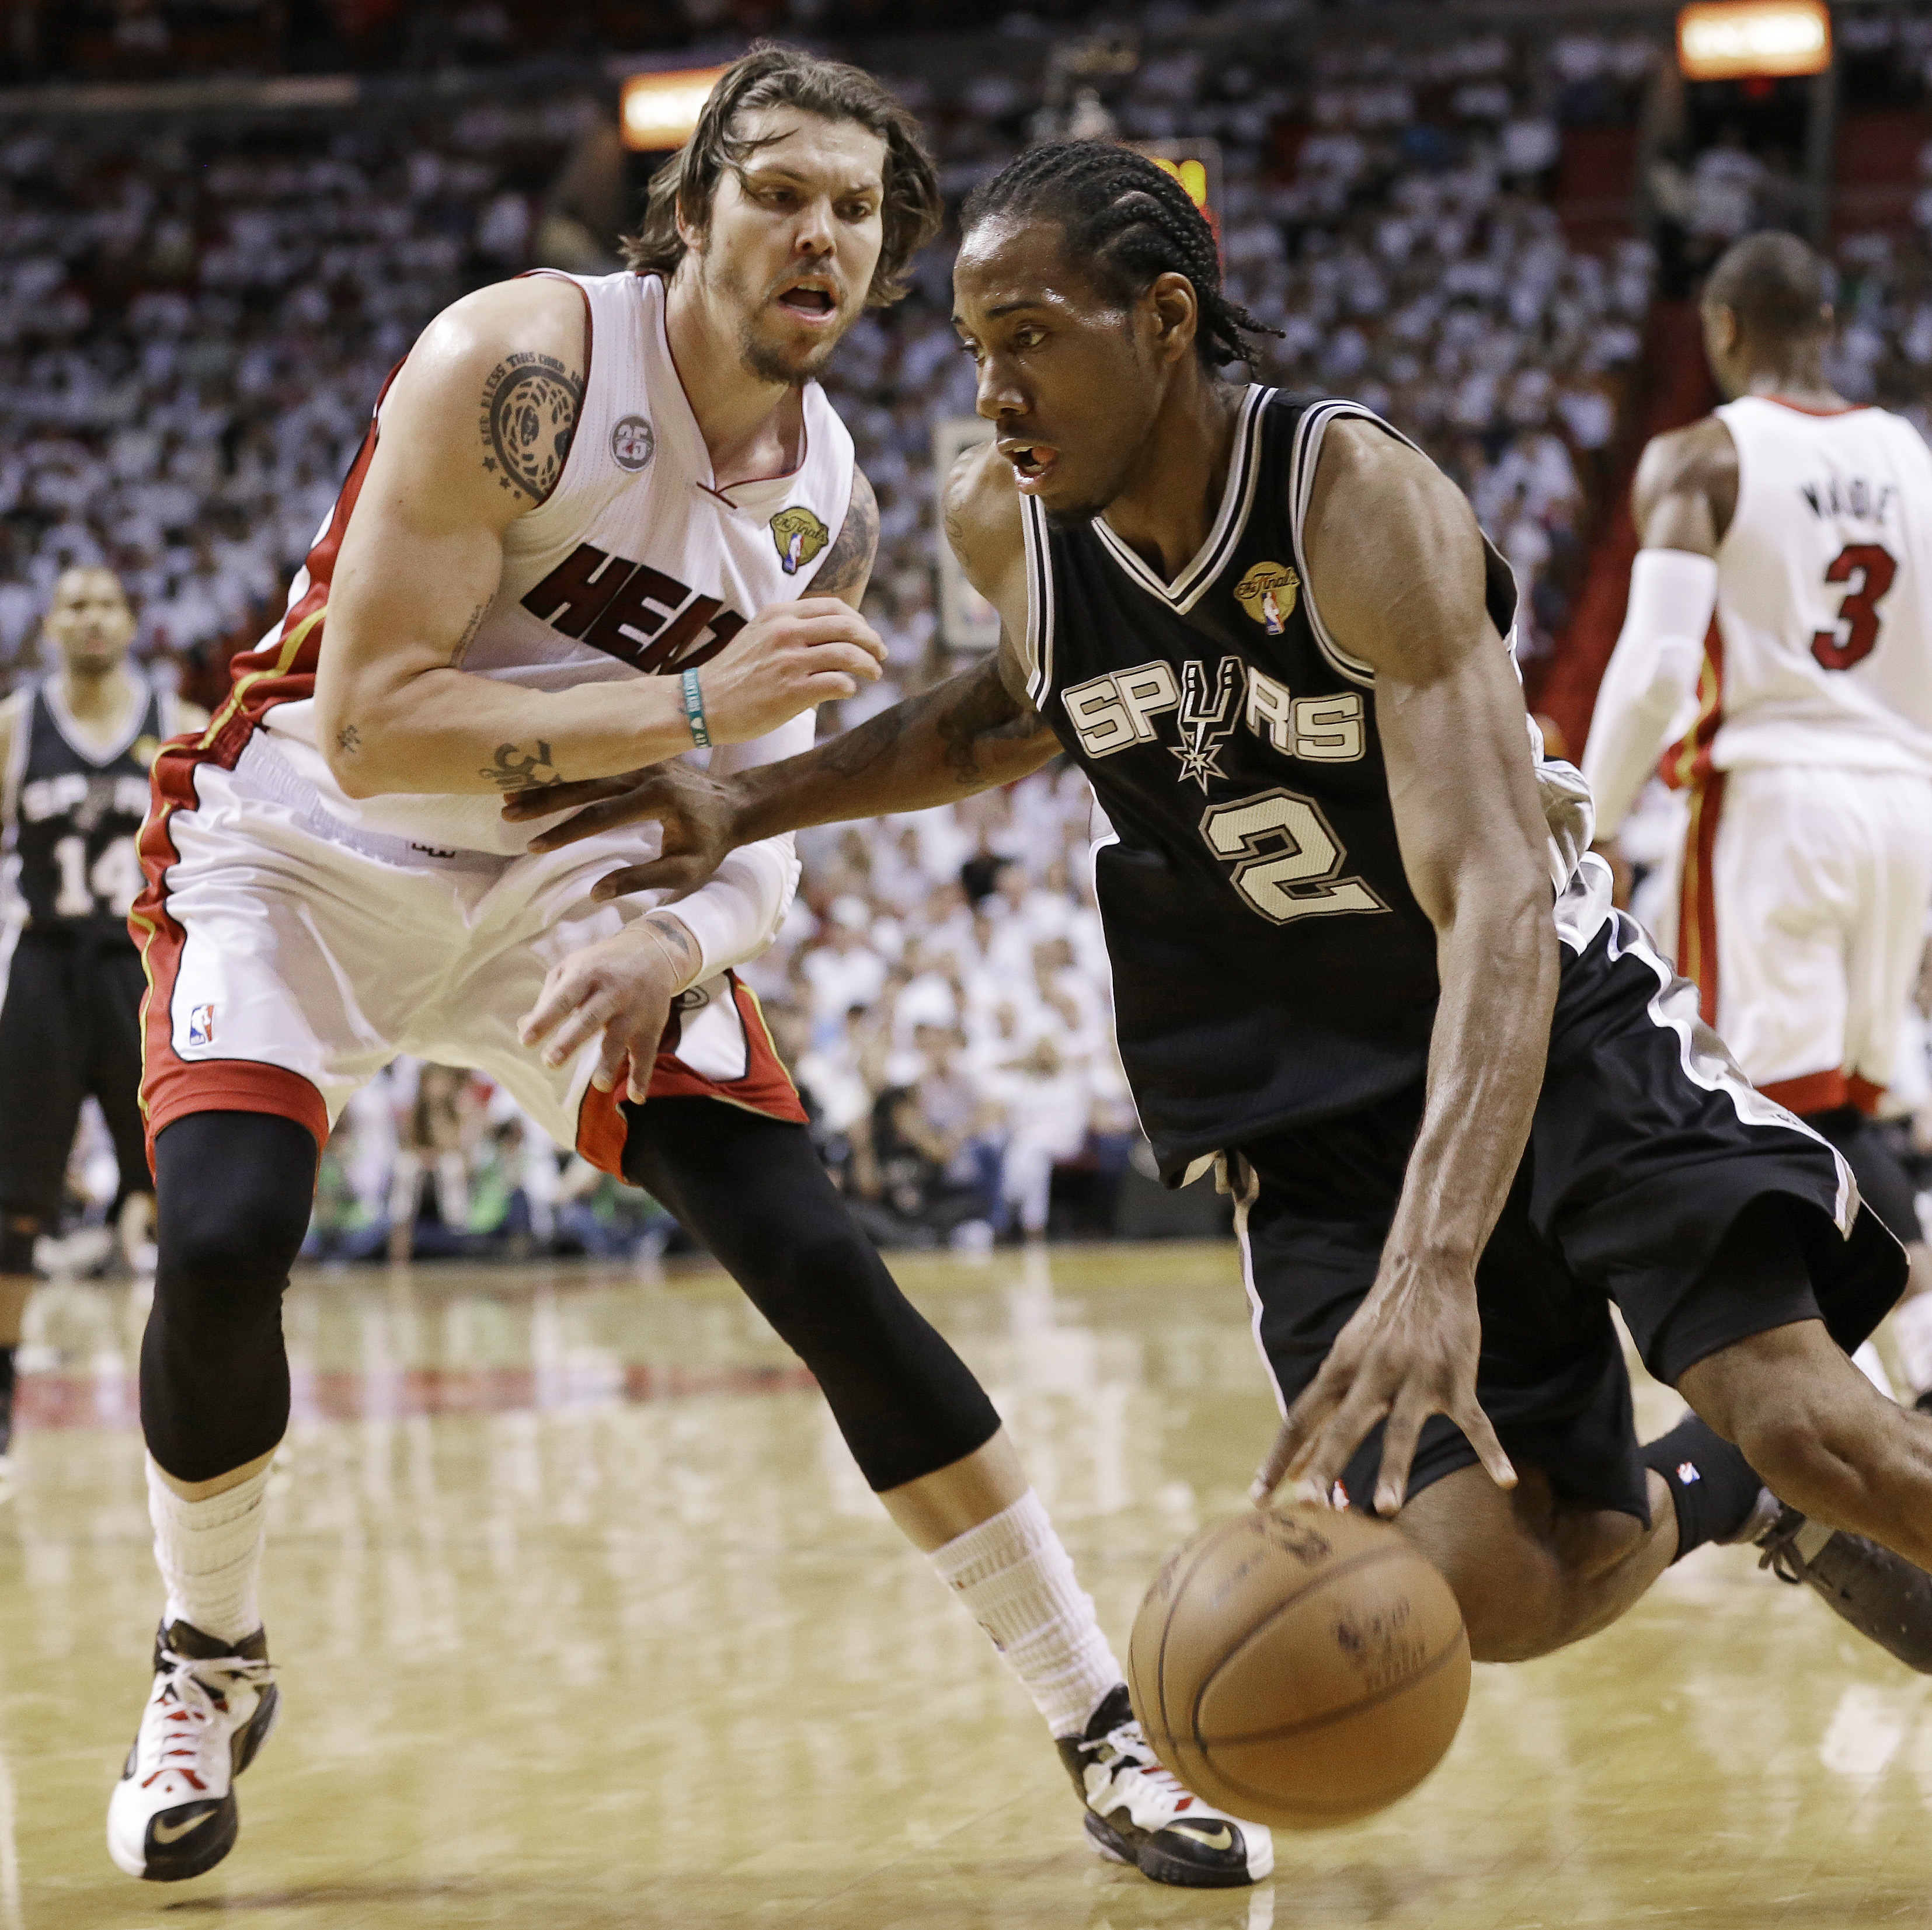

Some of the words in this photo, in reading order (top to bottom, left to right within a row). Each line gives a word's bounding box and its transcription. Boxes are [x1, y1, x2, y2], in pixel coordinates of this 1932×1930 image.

[520, 542, 750, 676] HEA
[1252, 571, 1300, 591] Finals
[1811, 543, 1897, 672] 3
[1061, 655, 1367, 795] SPURS
[54, 835, 144, 918] 14
[1198, 787, 1393, 926] 2
